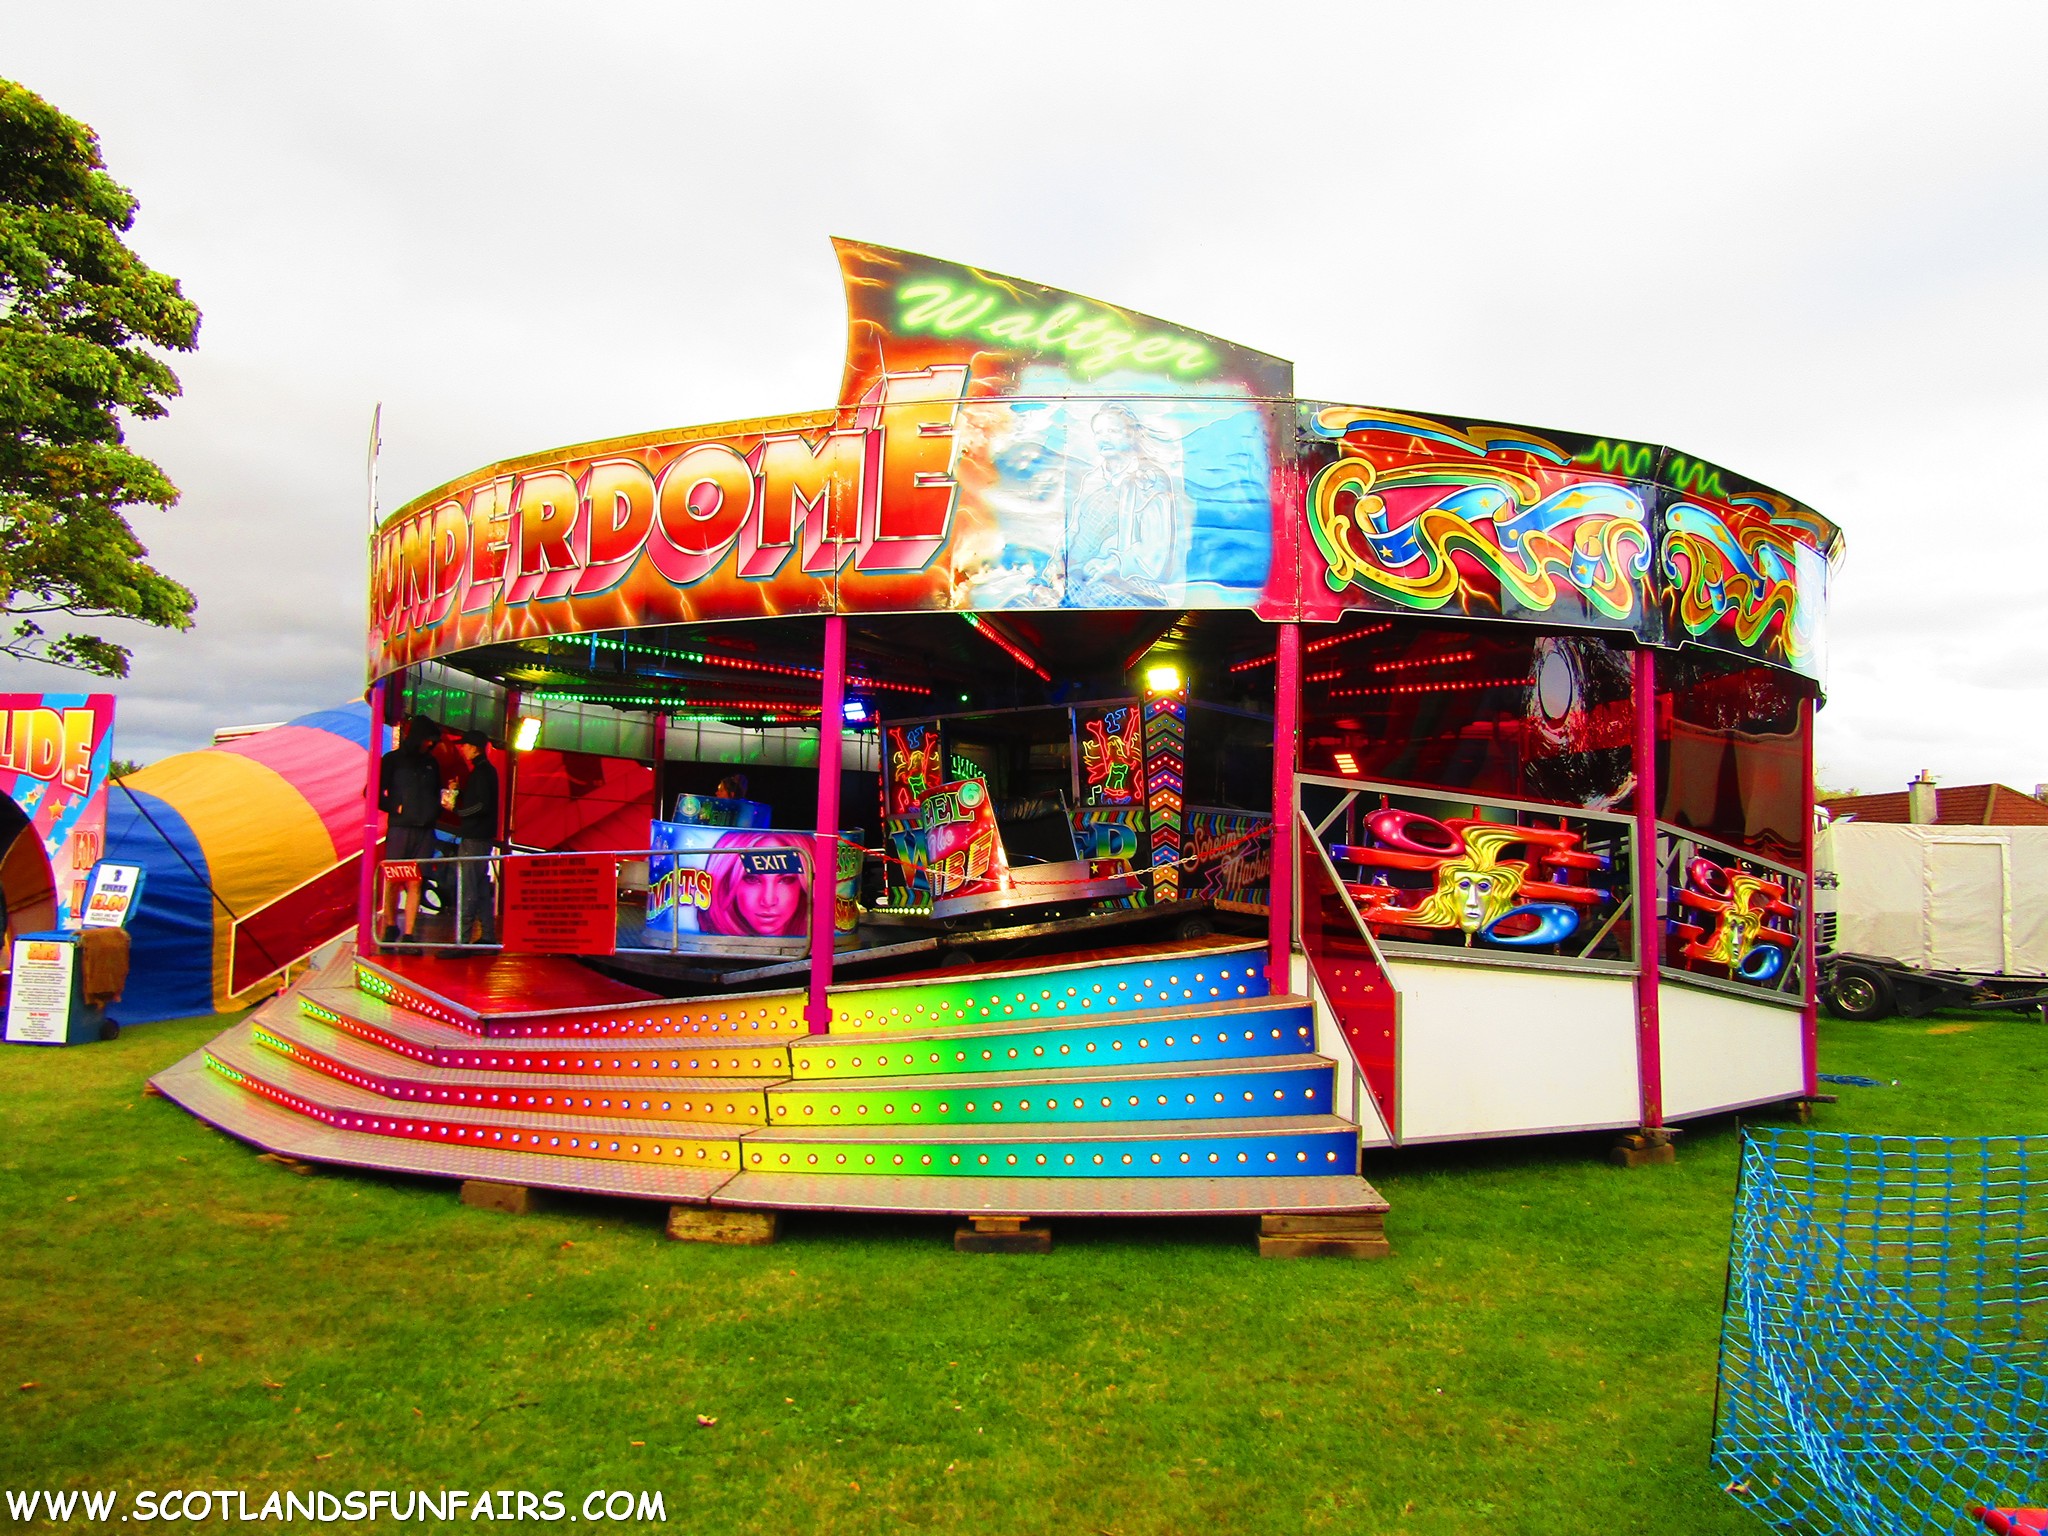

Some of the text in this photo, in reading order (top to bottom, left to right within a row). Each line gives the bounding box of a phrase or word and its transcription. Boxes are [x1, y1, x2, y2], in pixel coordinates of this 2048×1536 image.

[898, 283, 1206, 369] Waltzer
[371, 364, 971, 645] UNDERDOME
[1104, 707, 1128, 733] 1ST
[0, 708, 95, 796] LIDE
[961, 782, 982, 807] 6
[384, 865, 418, 878] ENTRY
[752, 854, 789, 871] EXIT
[1183, 827, 1240, 873] Scream
[1221, 848, 1271, 893] Machin
[646, 868, 713, 921] MITS
